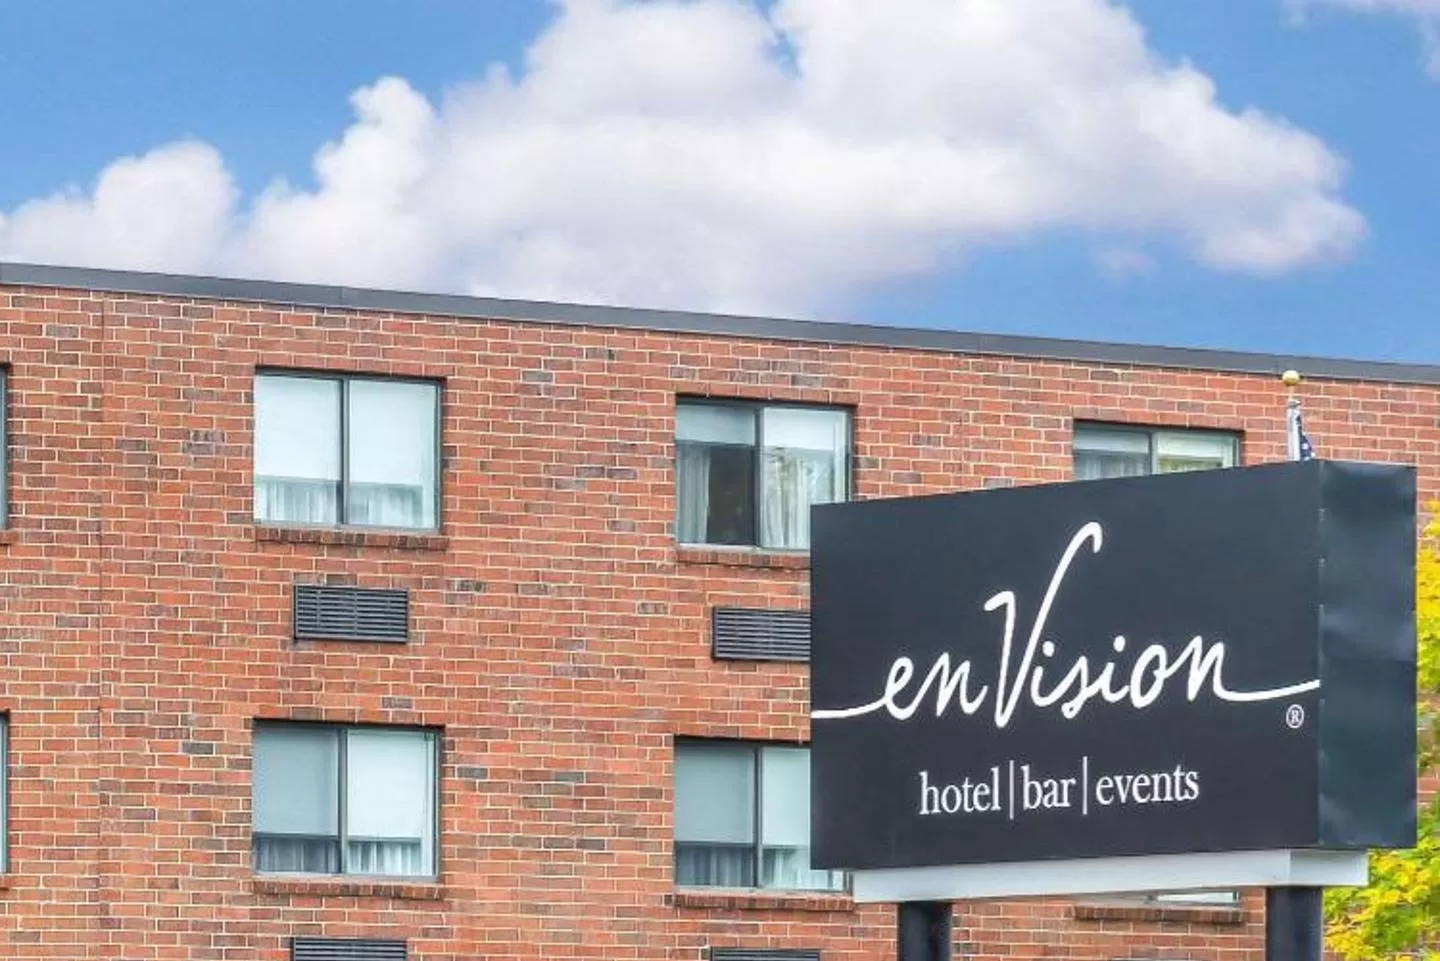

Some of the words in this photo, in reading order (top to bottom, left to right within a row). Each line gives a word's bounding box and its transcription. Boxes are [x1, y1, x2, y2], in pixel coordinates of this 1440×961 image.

[918, 766, 1002, 816] hotel
[1021, 764, 1077, 811] bar
[1095, 763, 1201, 806] events
